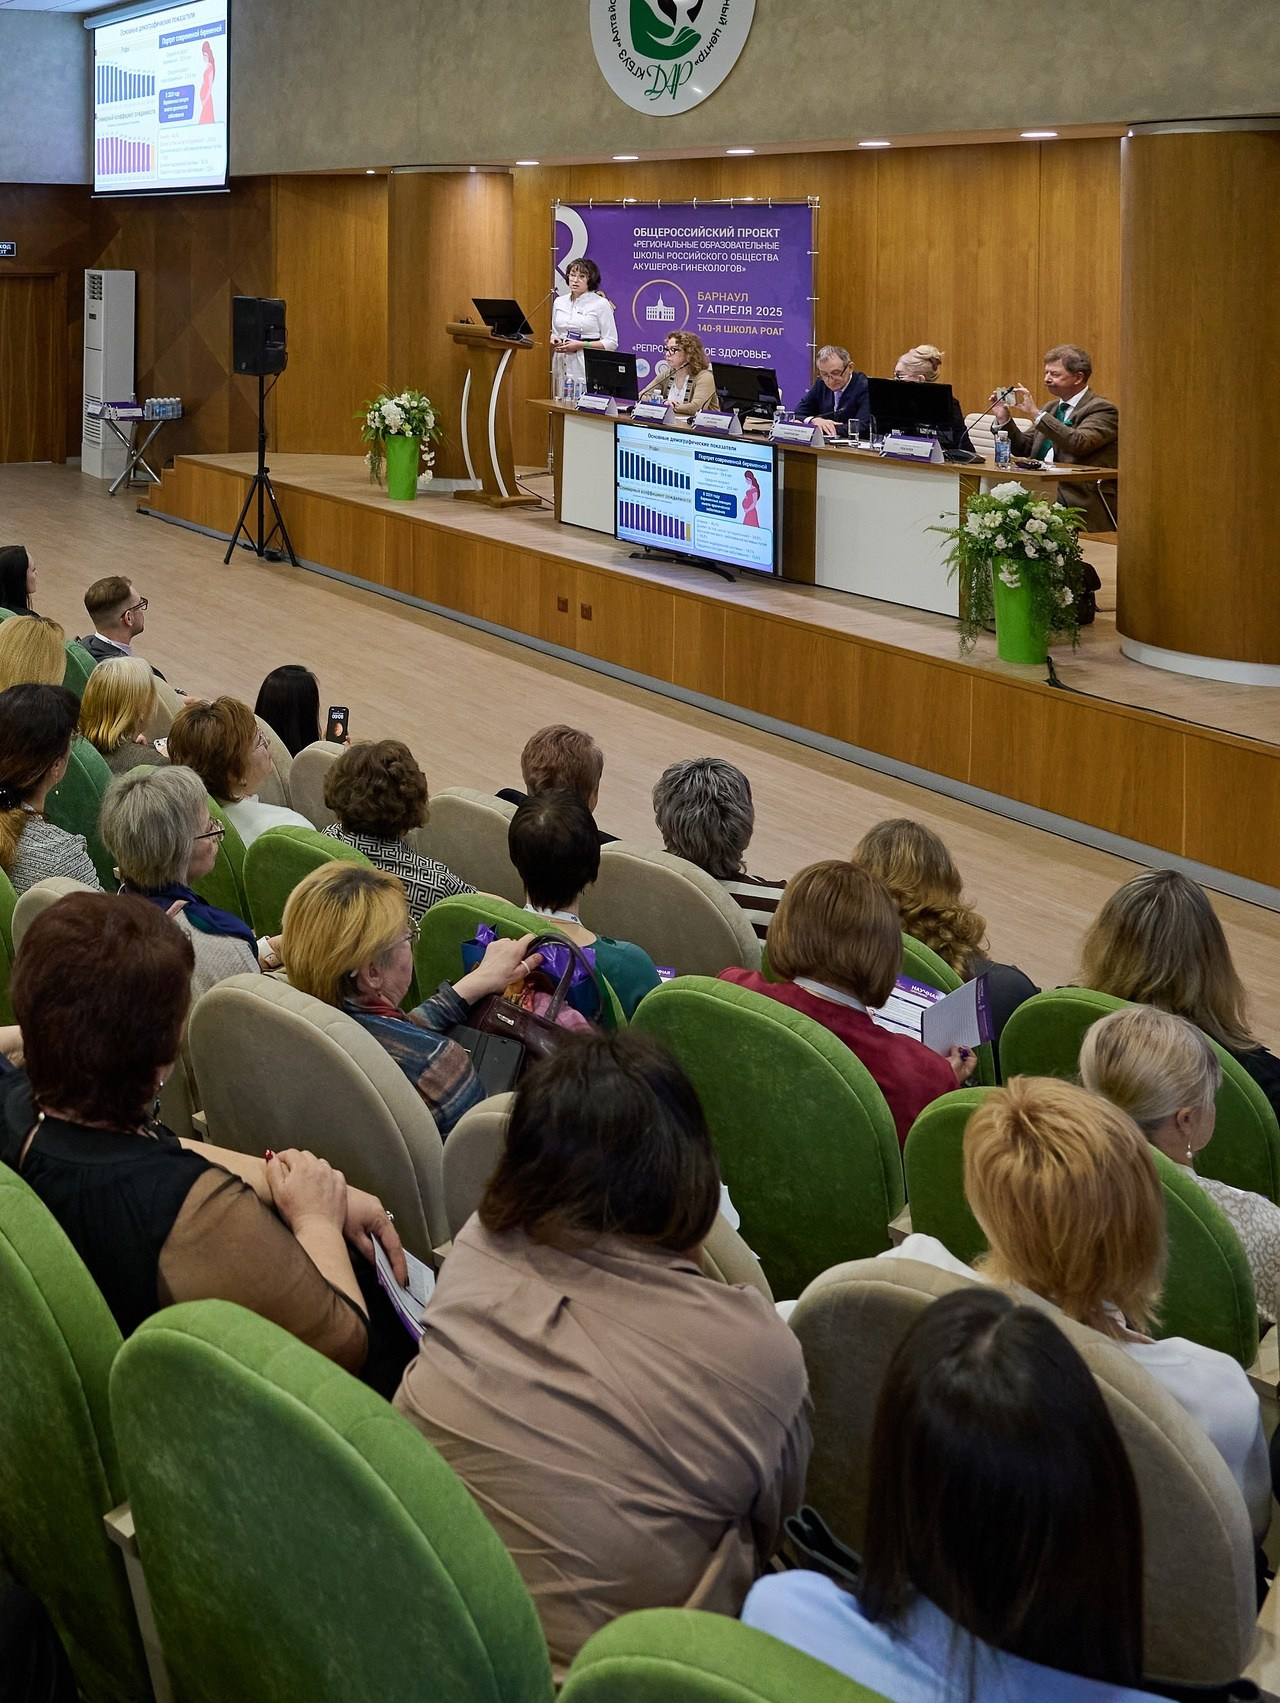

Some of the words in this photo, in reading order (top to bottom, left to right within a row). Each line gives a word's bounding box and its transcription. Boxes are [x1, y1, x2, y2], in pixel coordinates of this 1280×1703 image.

[618, 49, 646, 80] КГБУЗ
[643, 60, 694, 101] ДАР
[633, 226, 735, 238] ОБЩЕРОССИЙСКИЙ
[737, 228, 780, 238] ПРОЕКТ
[633, 240, 699, 249] «РЕГИОНАЛЬНЫЕ
[699, 240, 780, 250] ОБРАЗОВАТЕЛЬНЫЕ
[633, 251, 664, 260] ШКОЛЫ
[666, 251, 728, 261] РОССИЙСКОГО
[730, 252, 779, 262] ОБЩЕСТВА
[632, 262, 747, 273] АКУШЕРОВ-ГИНЕКОЛОГОВ»
[697, 291, 749, 302] БАРНАУЛ
[697, 304, 704, 313] 7
[706, 304, 752, 315] АПРЕЛЯ
[755, 306, 783, 317] 2025
[697, 323, 722, 333] 140-Я
[723, 325, 758, 335] ШКОЛА
[760, 327, 784, 336] РОАГ
[718, 348, 772, 359] ЗДОРОВЬЕ»
